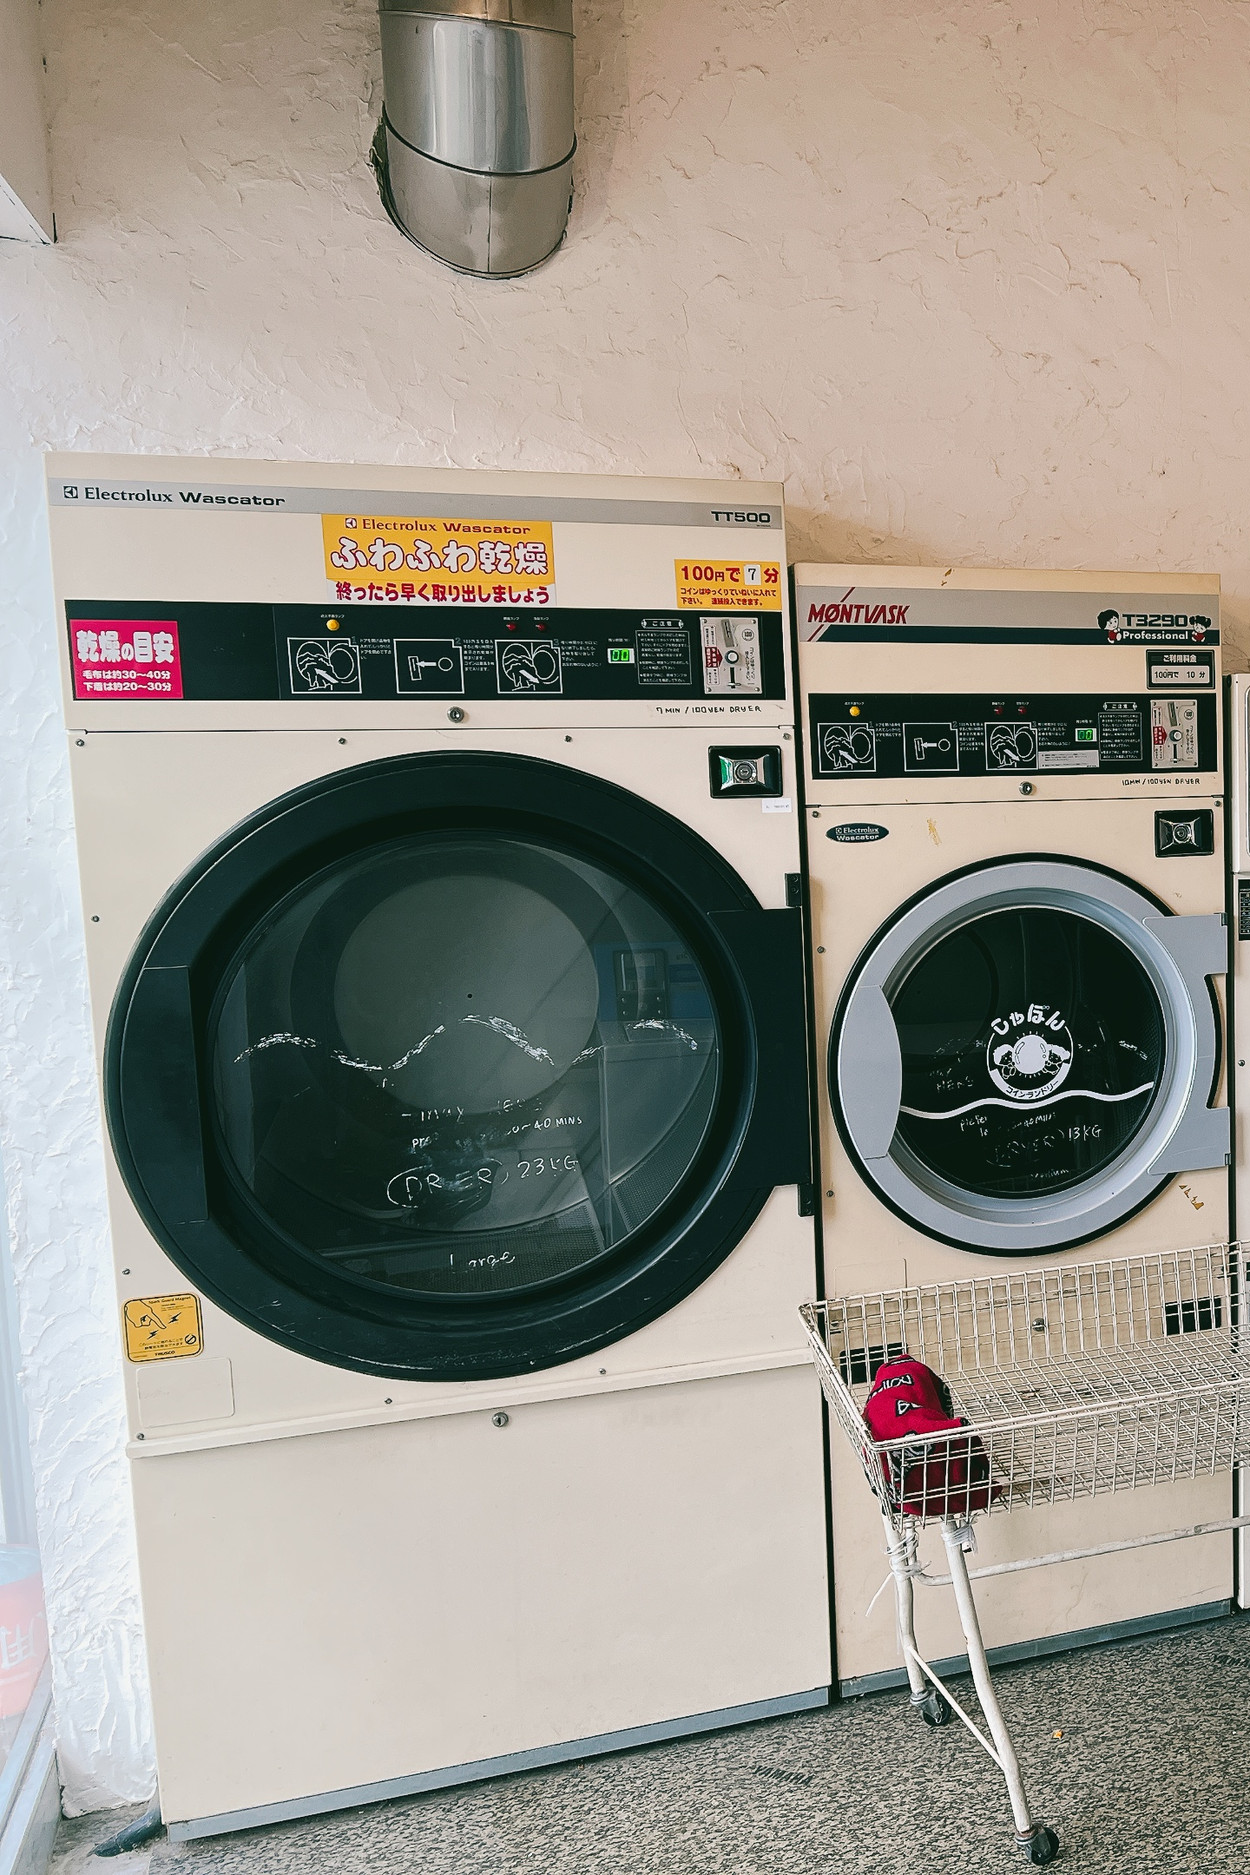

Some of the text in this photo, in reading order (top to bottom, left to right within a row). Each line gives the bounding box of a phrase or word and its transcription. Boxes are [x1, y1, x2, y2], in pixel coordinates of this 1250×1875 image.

[84, 487, 286, 507] Electrolux Wascator
[711, 510, 771, 523] TT500
[362, 518, 531, 535] Electrolux Wascator
[330, 535, 549, 576] ふわふわ乾燥
[681, 565, 779, 583] 100円で 7 分
[335, 581, 550, 604] 終ったら早く取り出しましょう
[1122, 613, 1188, 627] T3290
[1122, 630, 1189, 640] Professional
[76, 630, 175, 664] 乾燥の目安
[729, 705, 761, 713] DRYER
[1005, 1080, 1060, 1099] コインランドリー
[555, 1115, 583, 1128] MINS
[405, 1167, 493, 1201] DRER
